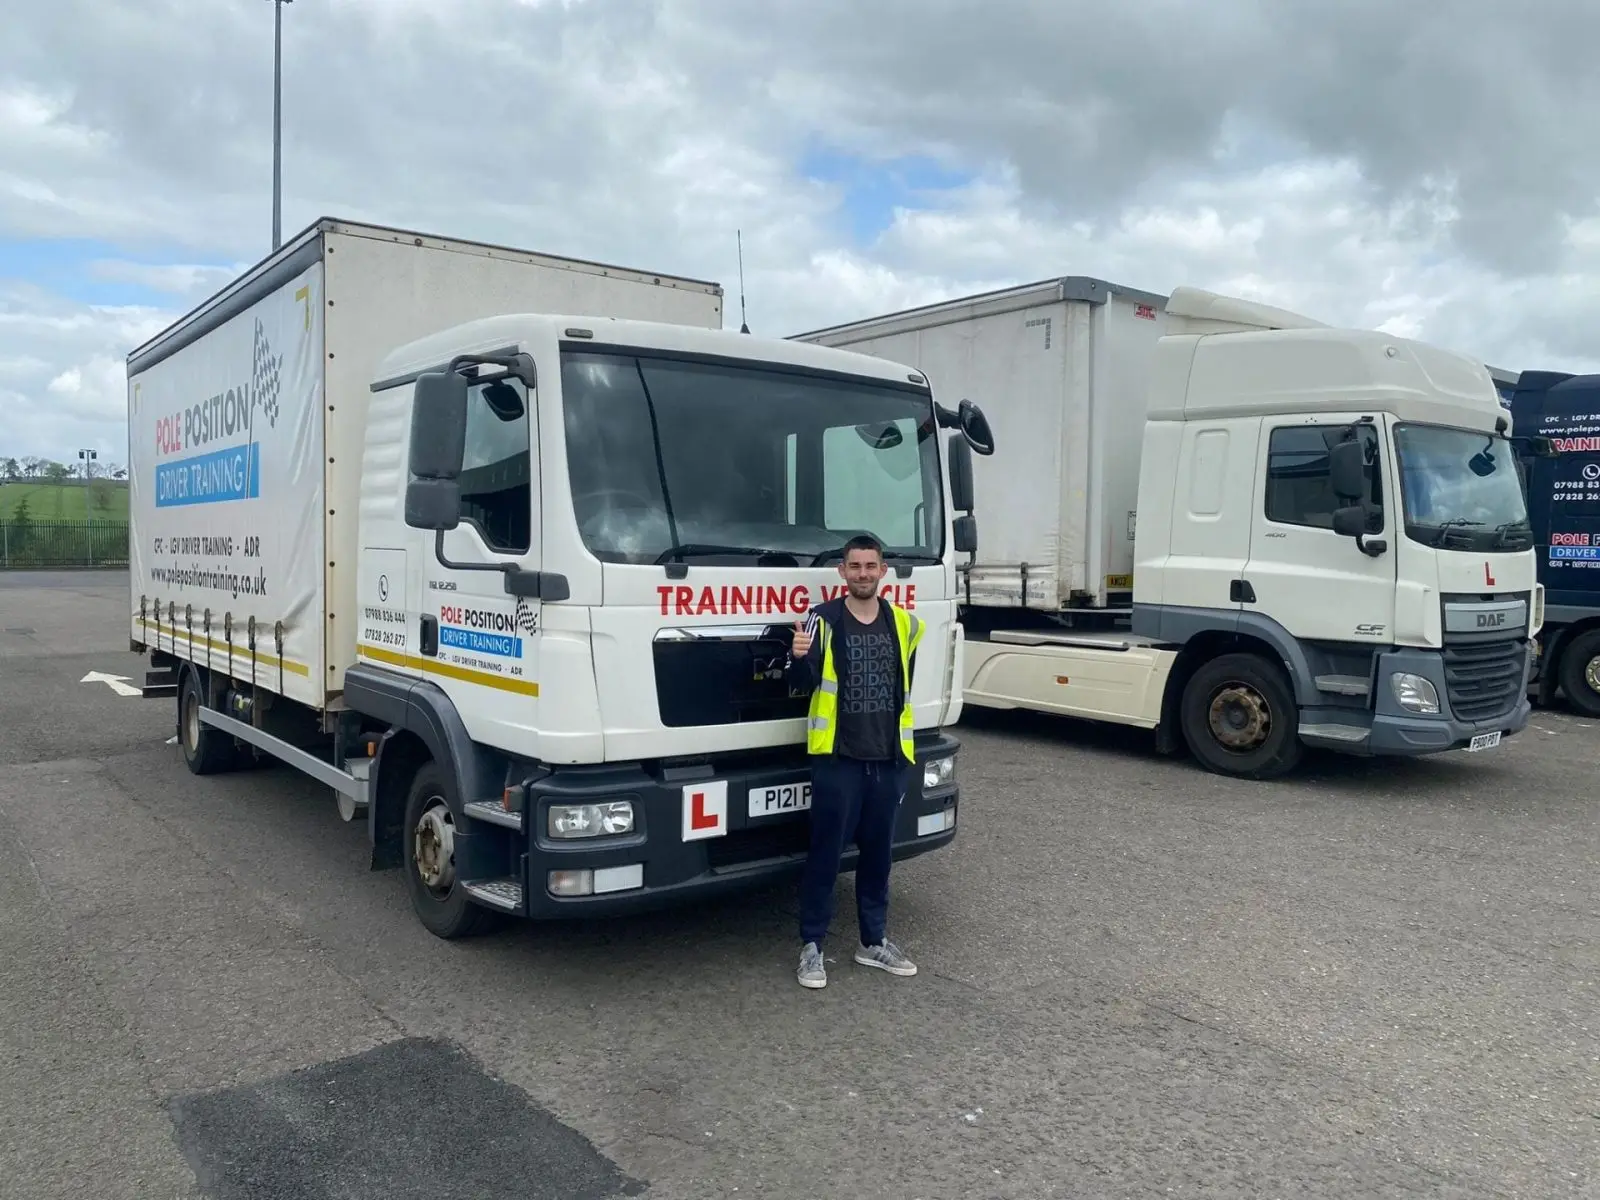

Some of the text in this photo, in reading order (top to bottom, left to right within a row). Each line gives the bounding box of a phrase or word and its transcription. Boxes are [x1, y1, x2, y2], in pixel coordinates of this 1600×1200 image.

[156, 382, 249, 456] POLE POSITION
[160, 454, 243, 500] DRIVER TRAINING
[1554, 481, 1584, 489] 07988
[1553, 493, 1583, 501] 07828
[154, 537, 163, 554] CPC
[170, 537, 180, 555] LGV
[181, 537, 201, 555] DRIVER
[202, 537, 233, 557] TRAINING
[244, 536, 261, 557] ADR
[1552, 533, 1589, 546] POLE
[1557, 548, 1597, 558] DRIVER
[151, 560, 267, 600] www.polepositiontraining.co.uk
[1485, 562, 1495, 586] L
[656, 584, 810, 616] TRAINING
[441, 606, 515, 632] POLE POSITION
[1477, 613, 1505, 627] DAF
[443, 629, 510, 654] DRIVER TRAINING
[461, 656, 477, 667] DRIVER
[478, 660, 502, 672] TRAINING
[511, 666, 523, 675] ADR
[691, 793, 718, 830] L
